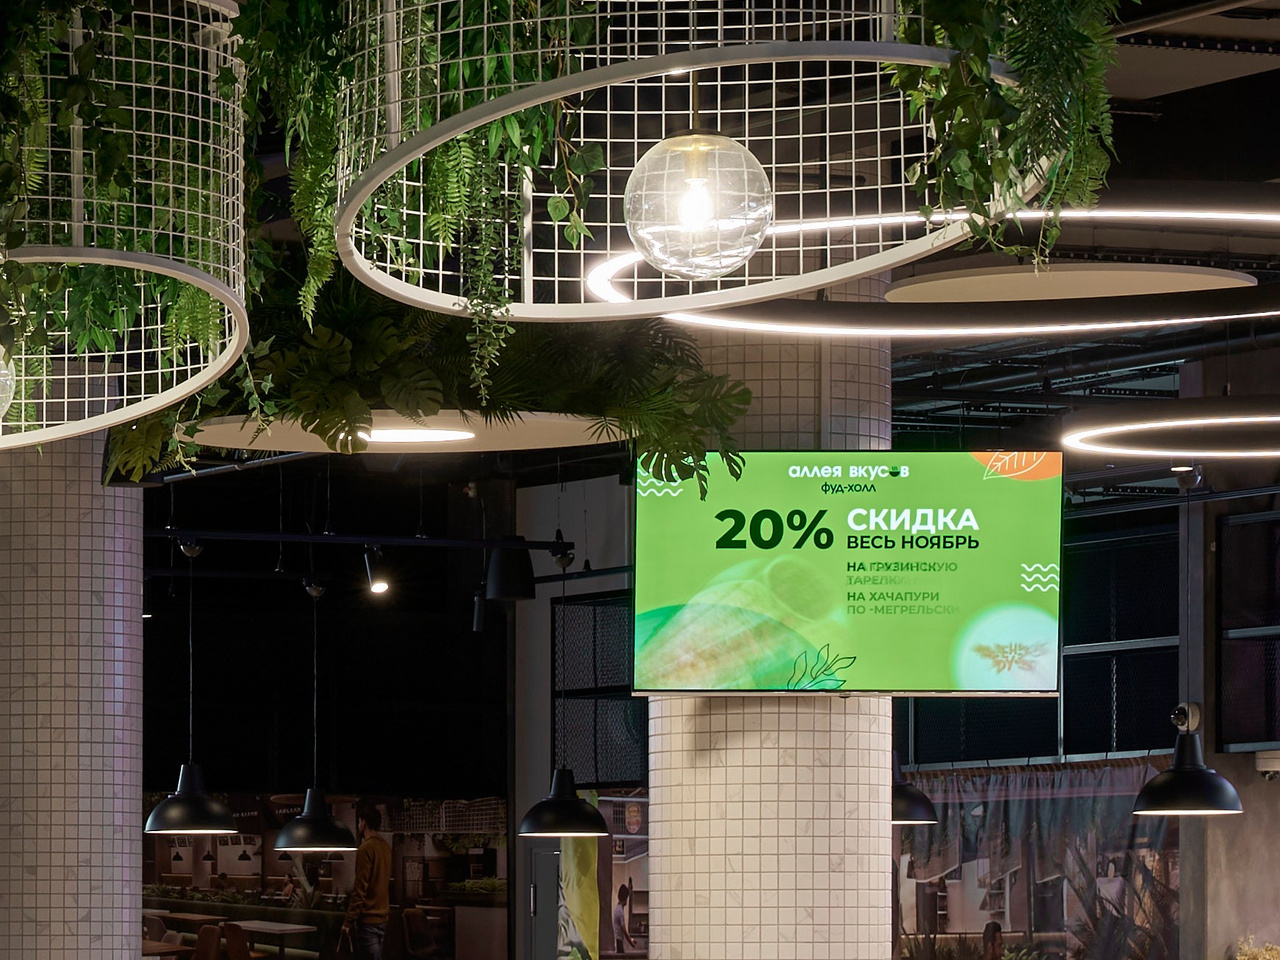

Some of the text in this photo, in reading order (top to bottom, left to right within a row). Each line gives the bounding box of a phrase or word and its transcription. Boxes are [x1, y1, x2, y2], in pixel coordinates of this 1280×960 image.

[788, 465, 842, 478] аллея
[821, 482, 876, 494] фуд-холл
[847, 508, 980, 534] СКИДКА
[714, 509, 835, 550] 20%
[847, 535, 980, 549] ВЕСЬ НОЯБРЬ
[847, 562, 958, 572] НА ГРУЗИНСКУЮ
[847, 592, 940, 601] НА ХАЧАПУРИ
[847, 605, 866, 615] ПО
